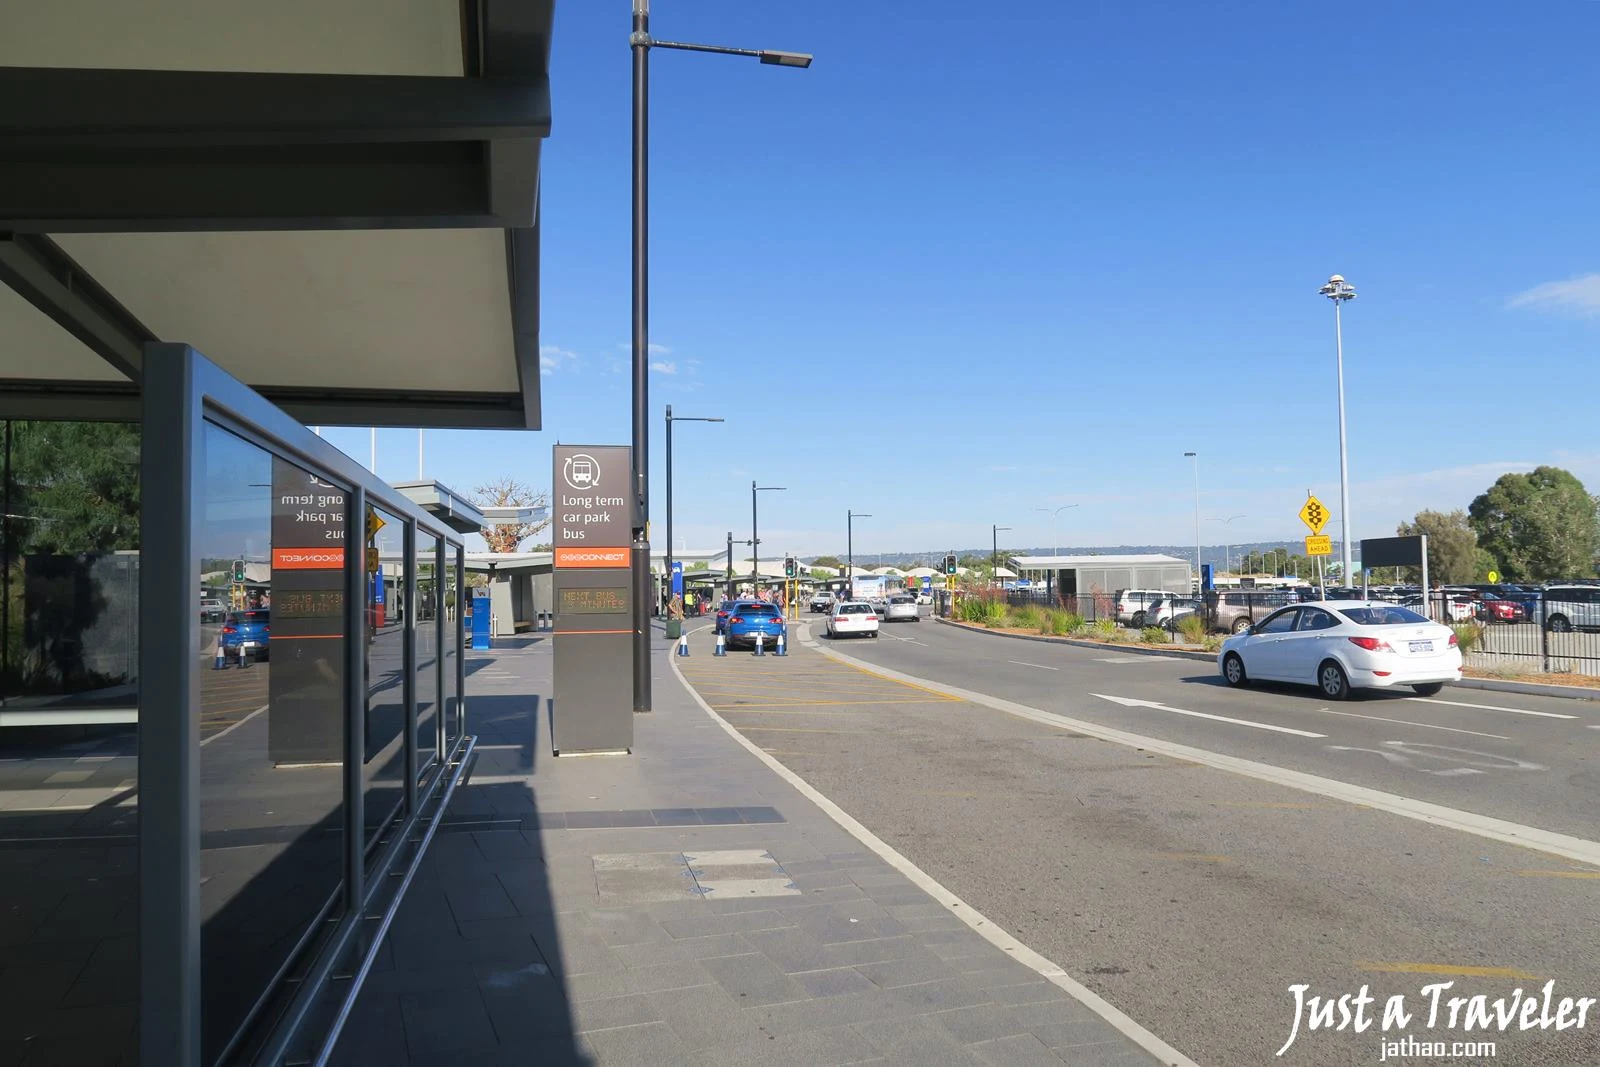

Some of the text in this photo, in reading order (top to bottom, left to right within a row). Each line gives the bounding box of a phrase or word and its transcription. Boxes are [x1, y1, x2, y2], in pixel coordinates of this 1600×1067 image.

[563, 495, 624, 508] Long term
[563, 511, 610, 525] car park
[563, 527, 585, 539] bus
[563, 591, 616, 601] NEXT BUS
